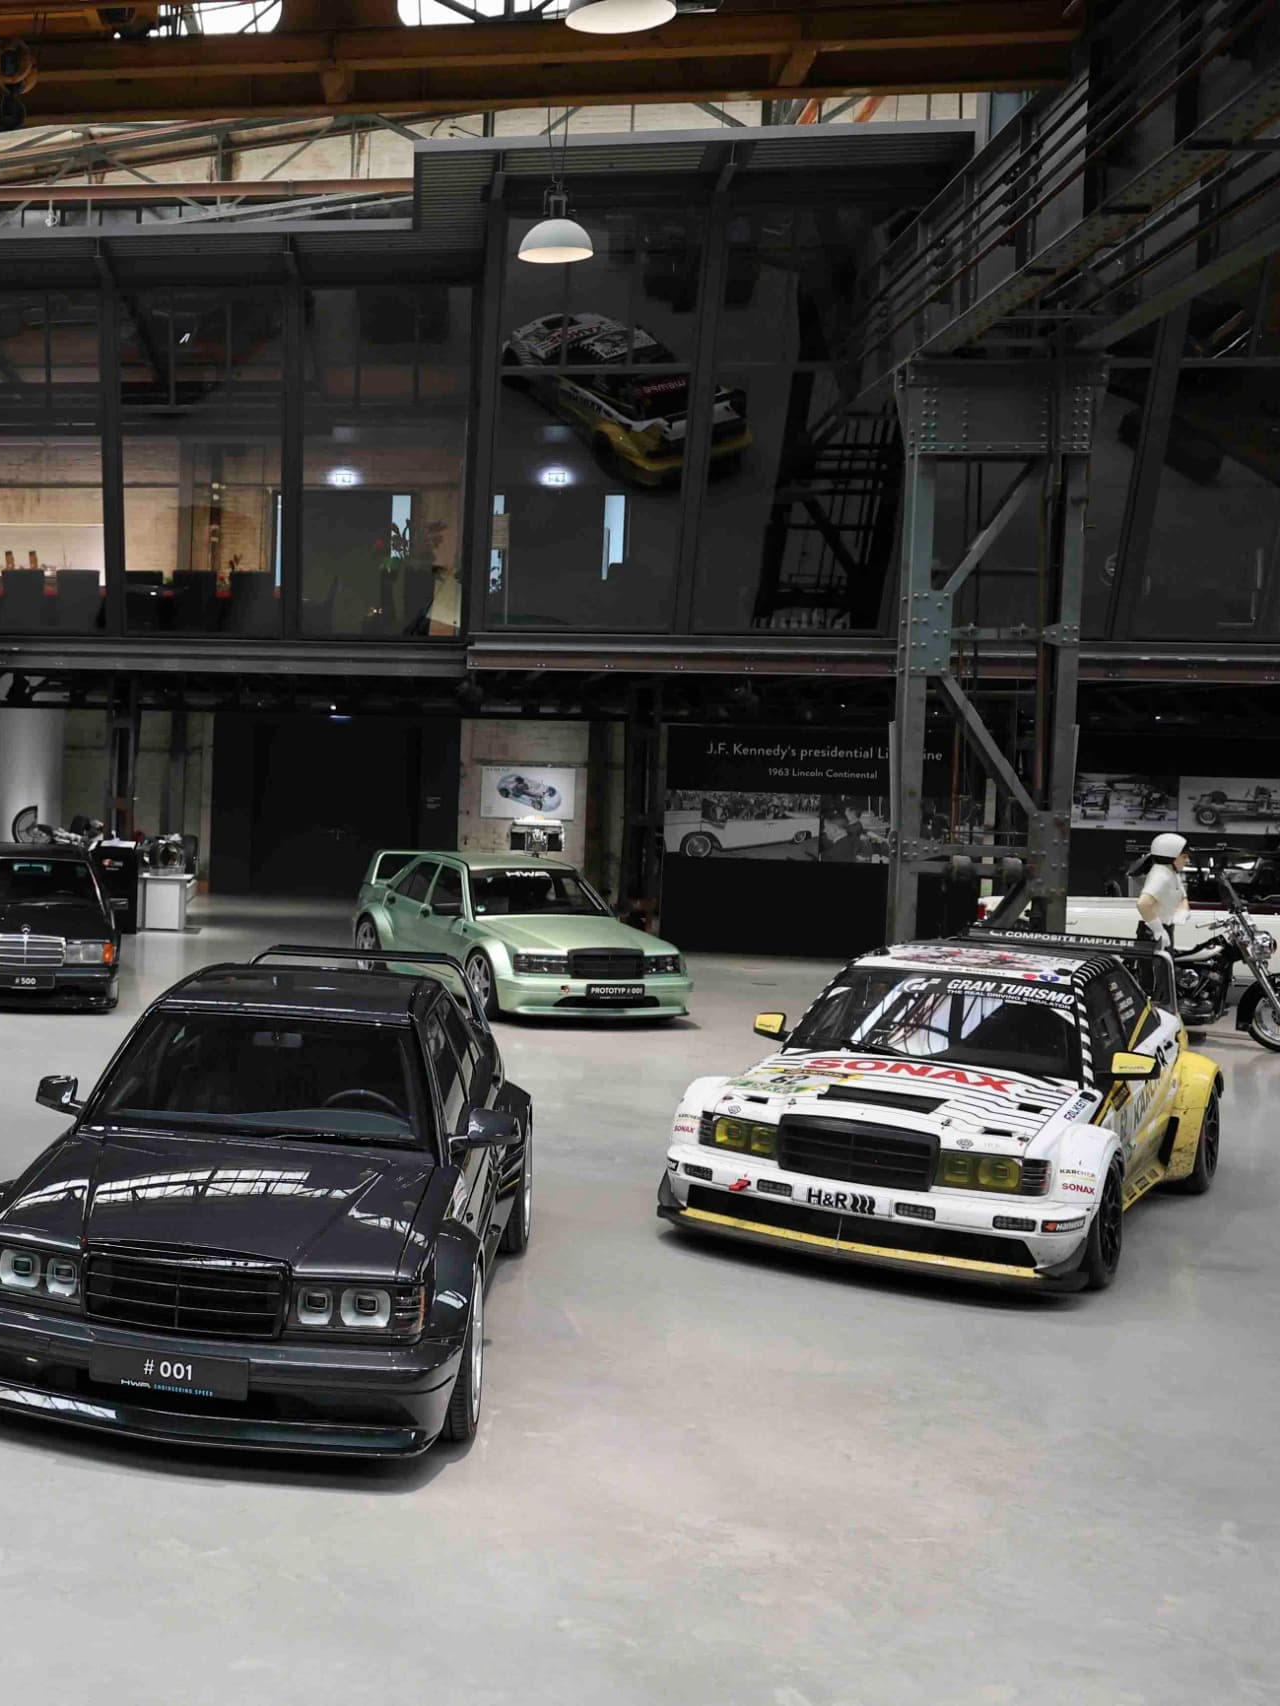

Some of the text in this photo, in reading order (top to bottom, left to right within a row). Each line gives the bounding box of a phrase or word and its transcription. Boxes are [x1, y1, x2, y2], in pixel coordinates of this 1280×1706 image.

[706, 742, 943, 761] J.F. Kennedy's presidential Liine
[768, 767, 878, 779] 1963 Lincoln Continental
[1006, 930, 1135, 948] COMPOSITE IMPULSE
[21, 977, 36, 985] 500
[947, 978, 1075, 1005] GRAN TURISMO
[987, 992, 1021, 1001] DRIVING
[1022, 997, 1071, 1010] SIMULATOR
[803, 1058, 1016, 1094] SONAX
[1062, 1182, 1095, 1195] SONAX
[807, 1186, 848, 1210] H&R
[144, 1358, 193, 1381] # 001
